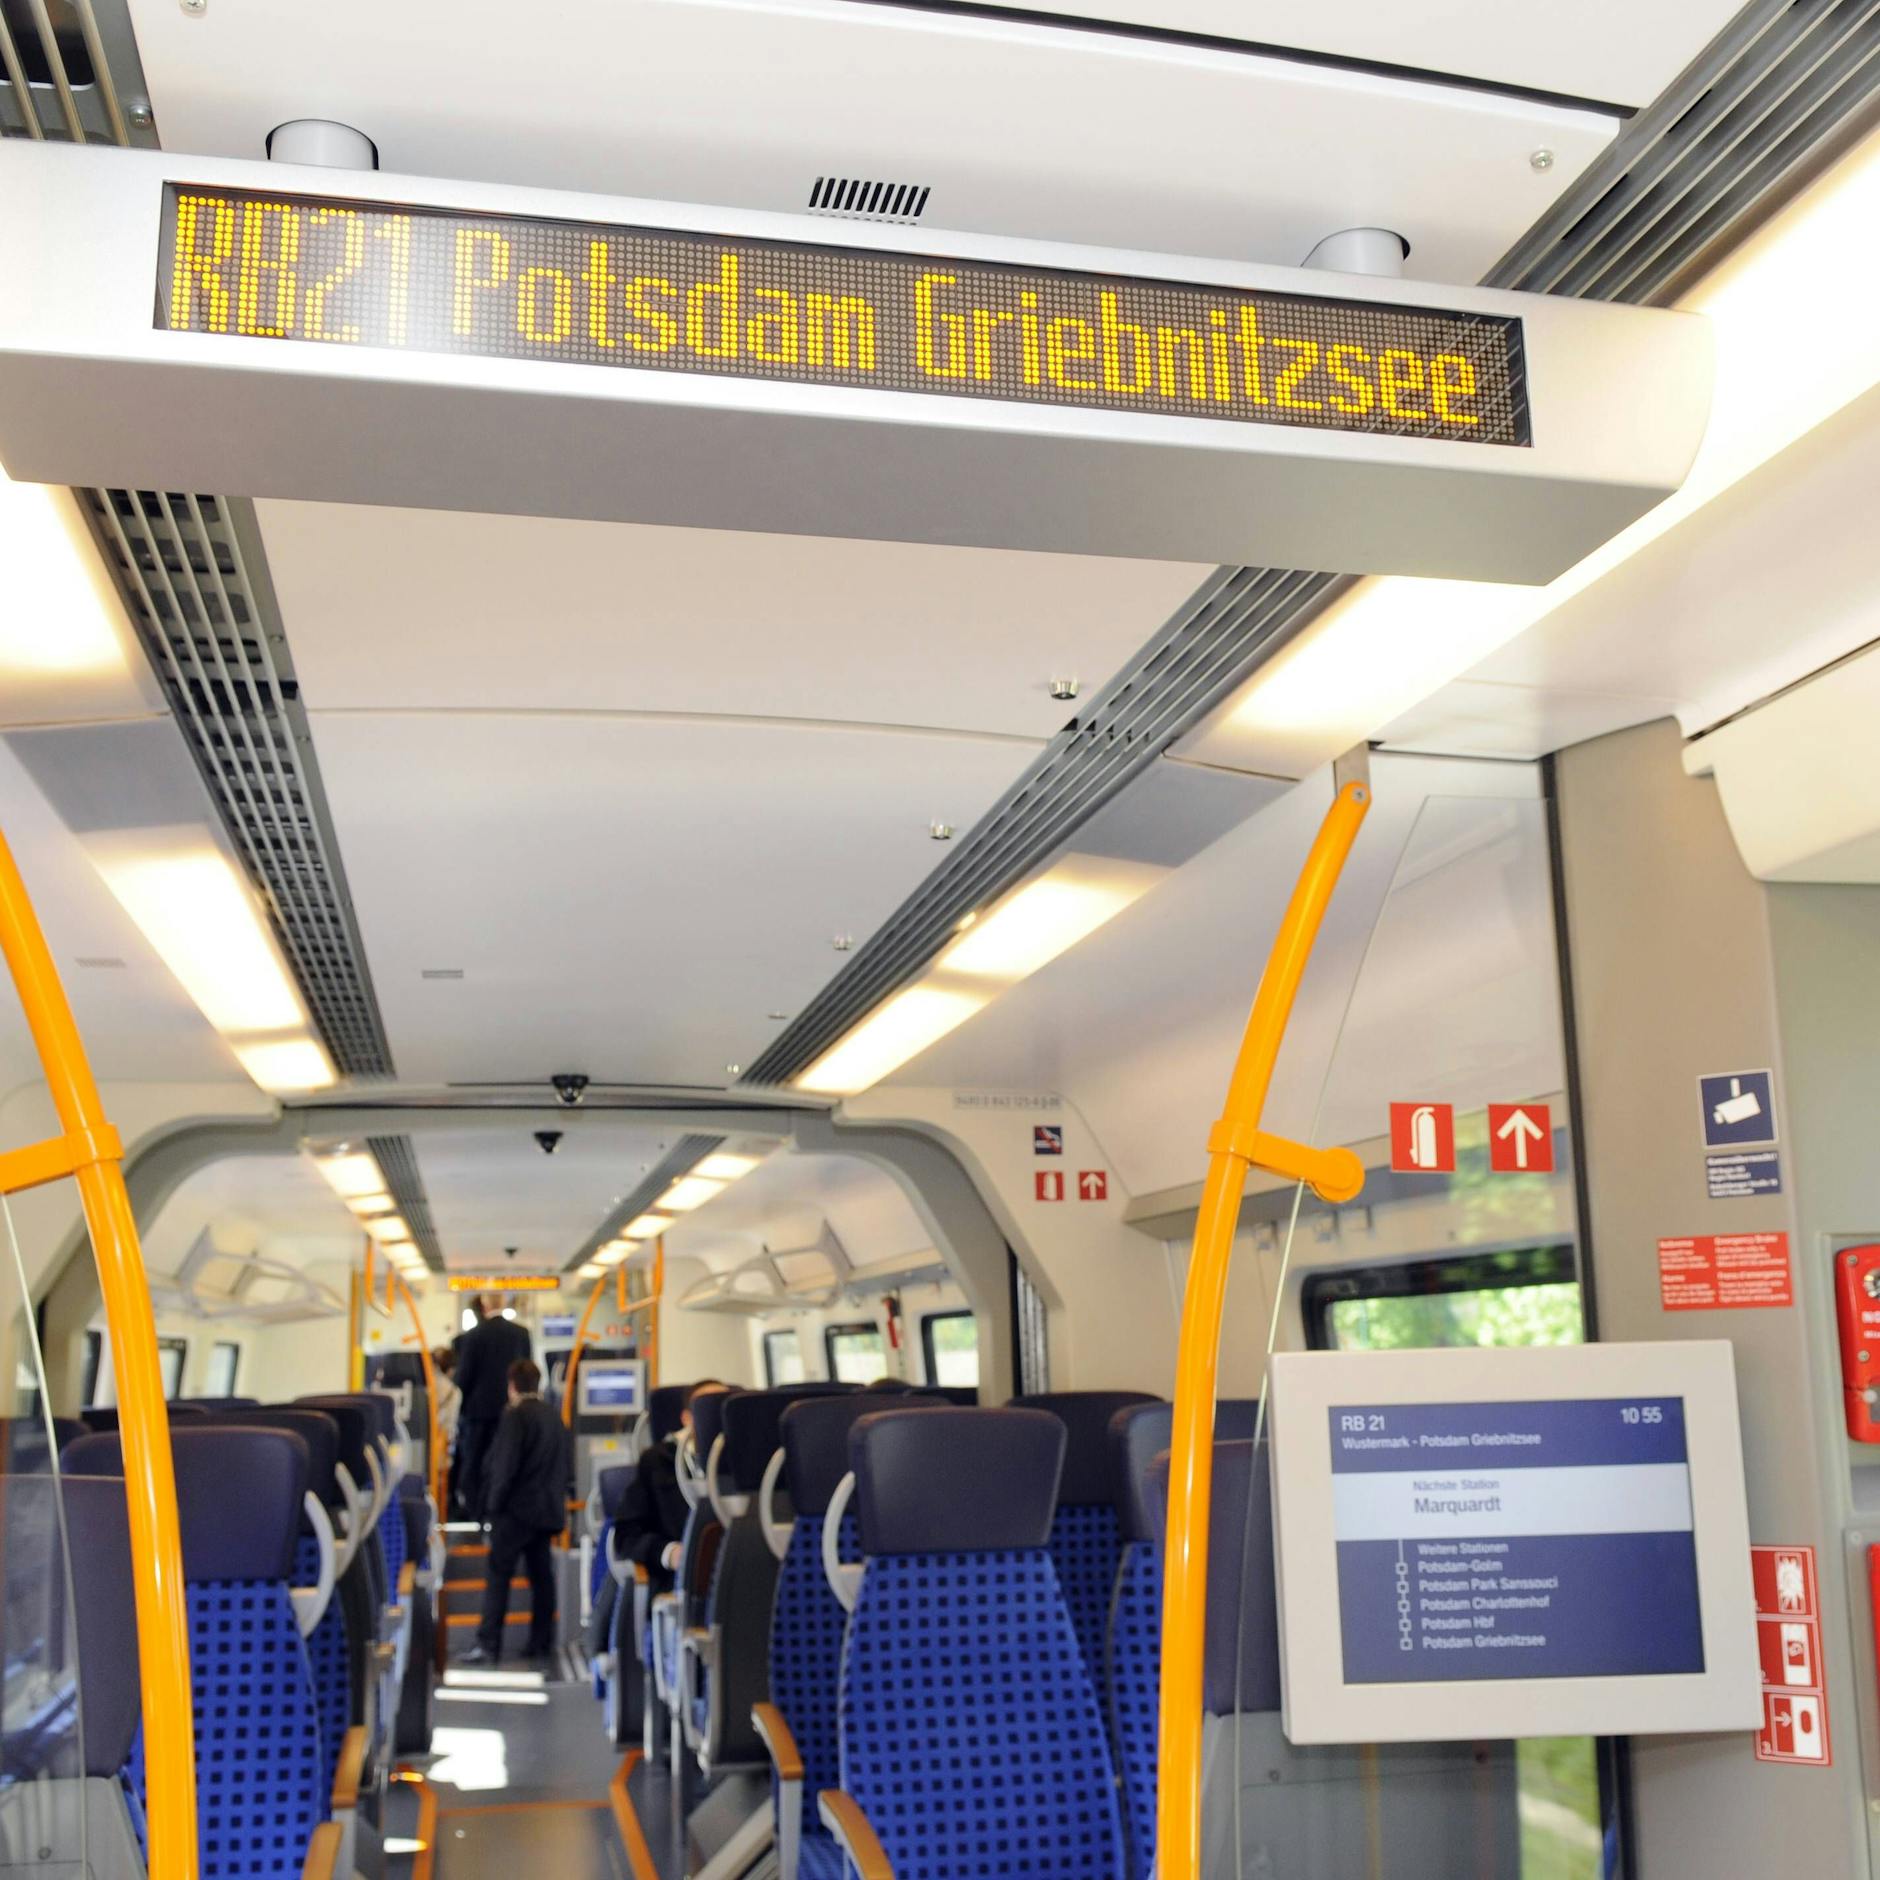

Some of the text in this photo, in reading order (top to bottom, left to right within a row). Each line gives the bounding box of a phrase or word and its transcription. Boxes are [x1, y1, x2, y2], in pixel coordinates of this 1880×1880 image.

[452, 228, 876, 371] Potsdam
[914, 272, 1479, 424] Griebnitzsee
[1341, 1414, 1385, 1432] RB 21
[1641, 1405, 1663, 1424] 55
[1342, 1436, 1410, 1450] Wustermark
[1419, 1434, 1470, 1448] Potsdam
[1471, 1432, 1542, 1446] Griebnitzsee
[1460, 1477, 1500, 1491] Station
[1414, 1495, 1502, 1516] Marquardt
[1459, 1541, 1509, 1554] Stationen
[1418, 1578, 1470, 1592] Potsdam
[1470, 1576, 1498, 1591] Park
[1420, 1594, 1550, 1611] Potsdam Charlottenhof
[1421, 1616, 1472, 1630] Potsdam
[1422, 1633, 1546, 1649] Potsdam Griebnitzsee
